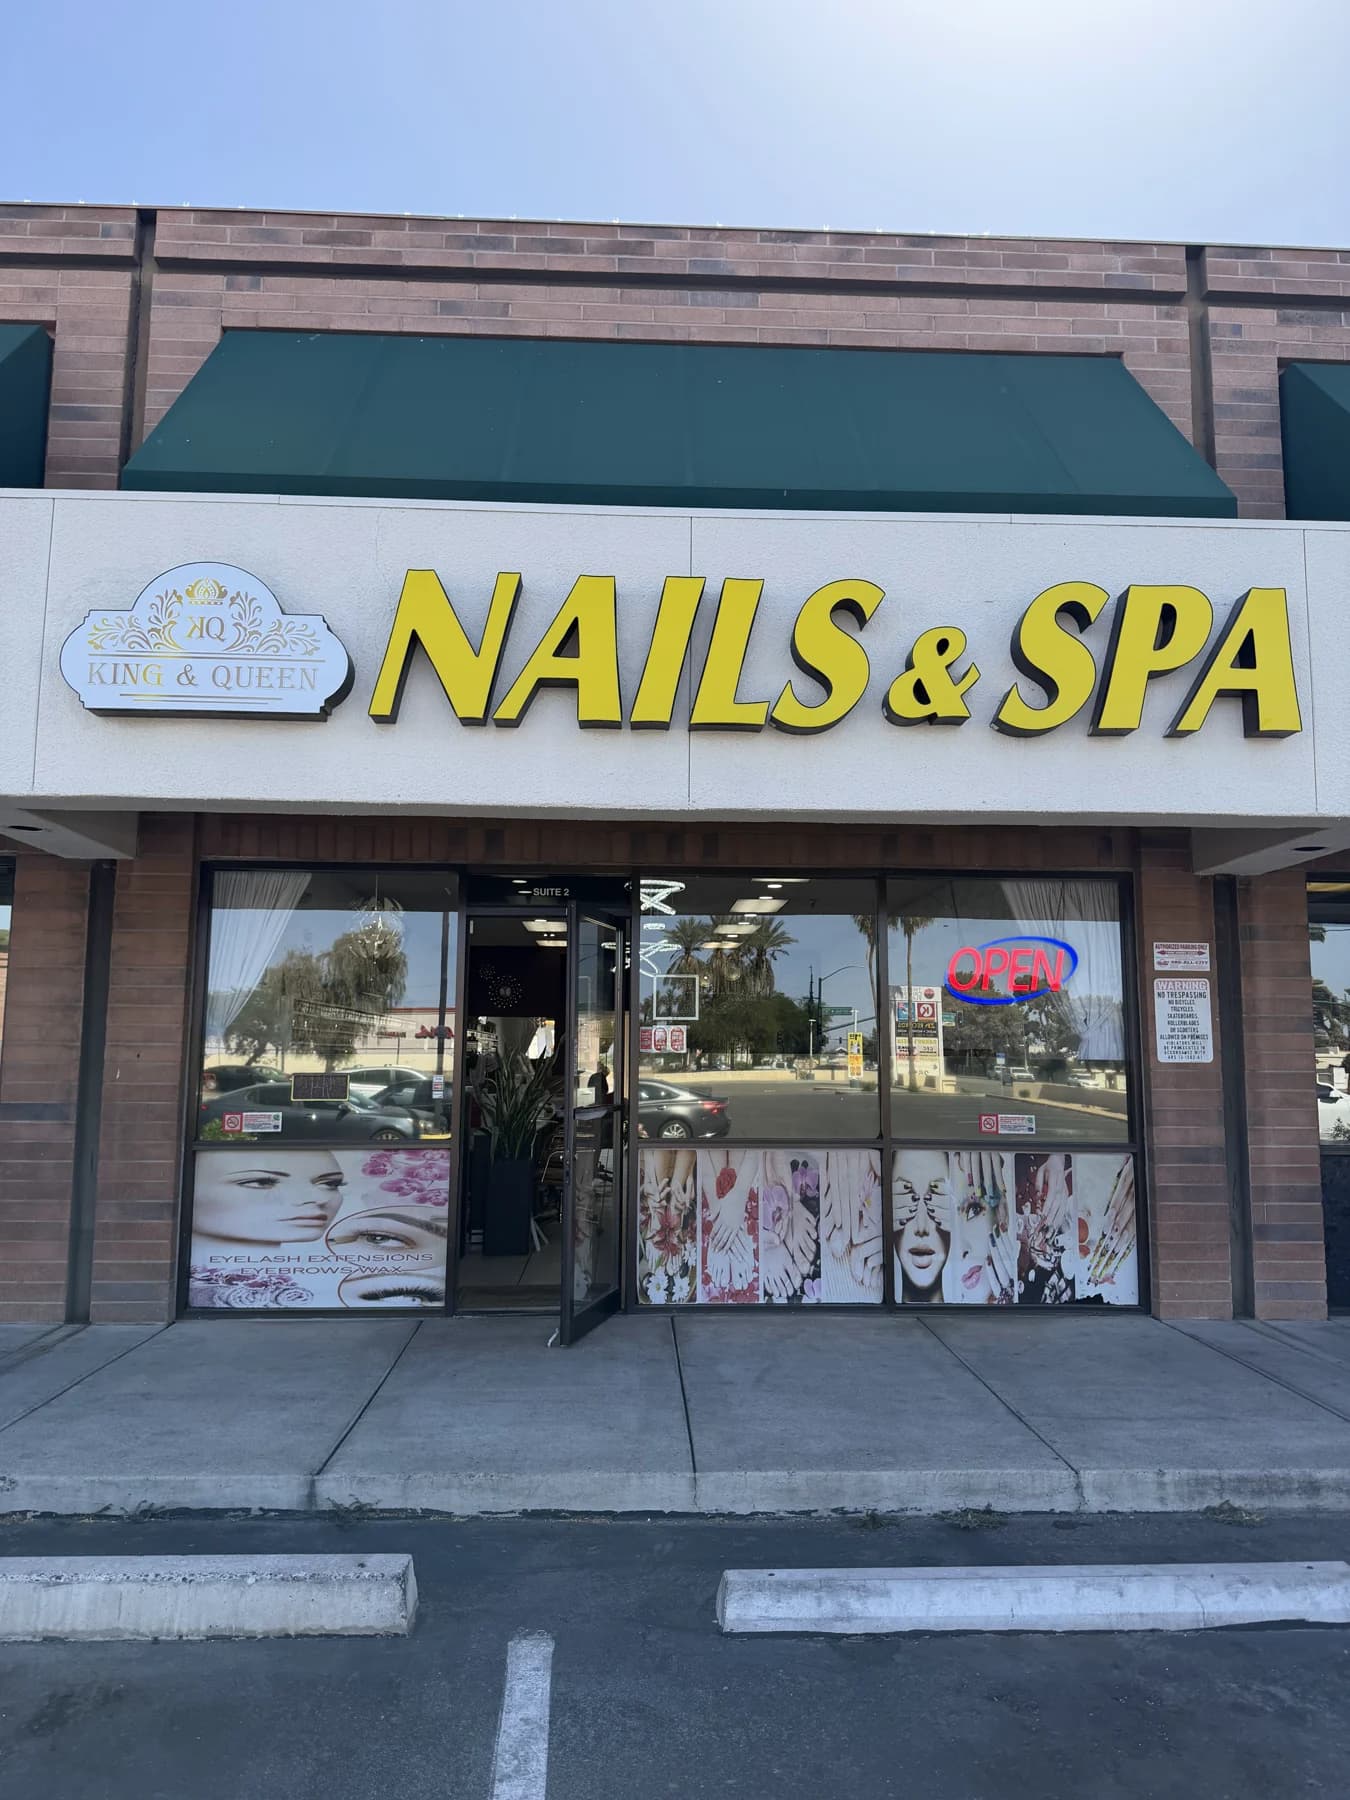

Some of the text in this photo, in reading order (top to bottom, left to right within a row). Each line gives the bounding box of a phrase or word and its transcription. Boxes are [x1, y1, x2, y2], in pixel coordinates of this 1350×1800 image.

[368, 569, 1303, 738] NAILS & SPA
[87, 661, 319, 691] KING & QUEEN
[532, 887, 570, 897] SUITE 2
[947, 945, 1065, 993] OPEN
[1158, 980, 1207, 991] WARNING
[1157, 991, 1207, 999] NO TRESPASSING
[209, 1253, 433, 1264] EYELASH EXTENSIONS
[241, 1266, 353, 1275] EYEBROWS
